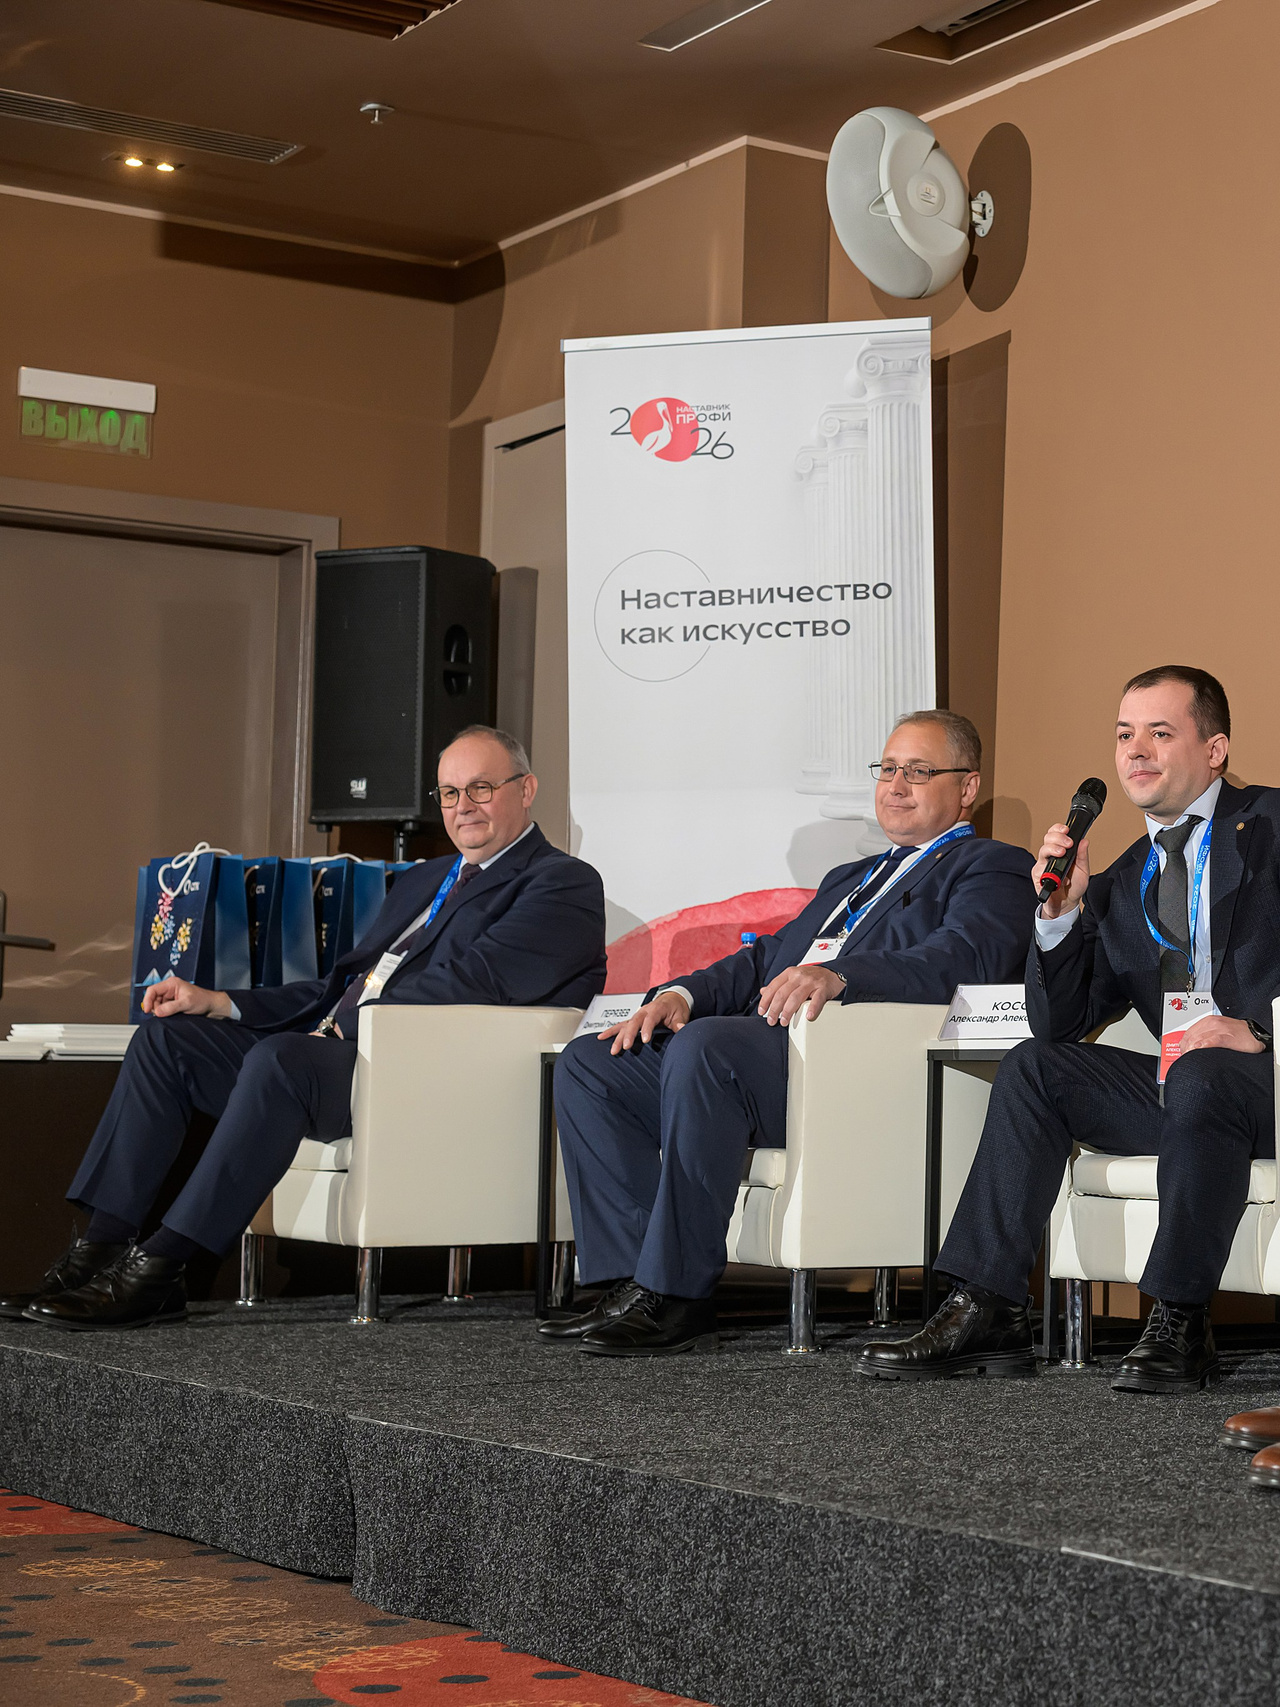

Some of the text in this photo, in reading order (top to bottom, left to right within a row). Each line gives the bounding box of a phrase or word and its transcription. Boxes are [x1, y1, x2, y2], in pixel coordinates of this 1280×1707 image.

[676, 404, 731, 414] НАСТАВНИК
[676, 411, 732, 425] ПРОФИ
[21, 399, 149, 456] ВЫХОД
[620, 581, 893, 611] Наставничество
[620, 618, 852, 646] как искусство
[949, 1015, 1000, 1023] Александр
